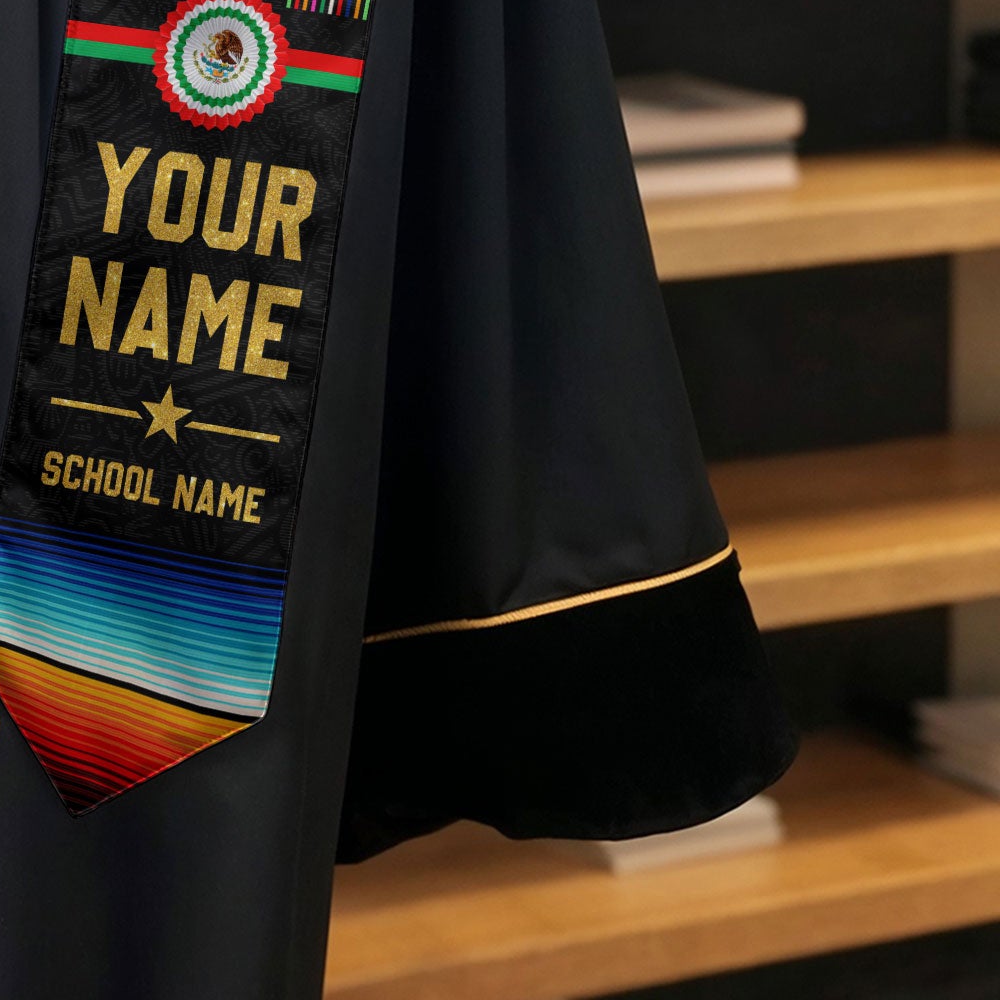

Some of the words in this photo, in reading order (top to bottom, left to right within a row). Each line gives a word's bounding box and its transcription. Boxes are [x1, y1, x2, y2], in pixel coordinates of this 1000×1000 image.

[96, 141, 318, 261] YOUR
[59, 255, 303, 380] NAME
[41, 451, 160, 505] SCHOOL
[172, 476, 266, 524] NAME
